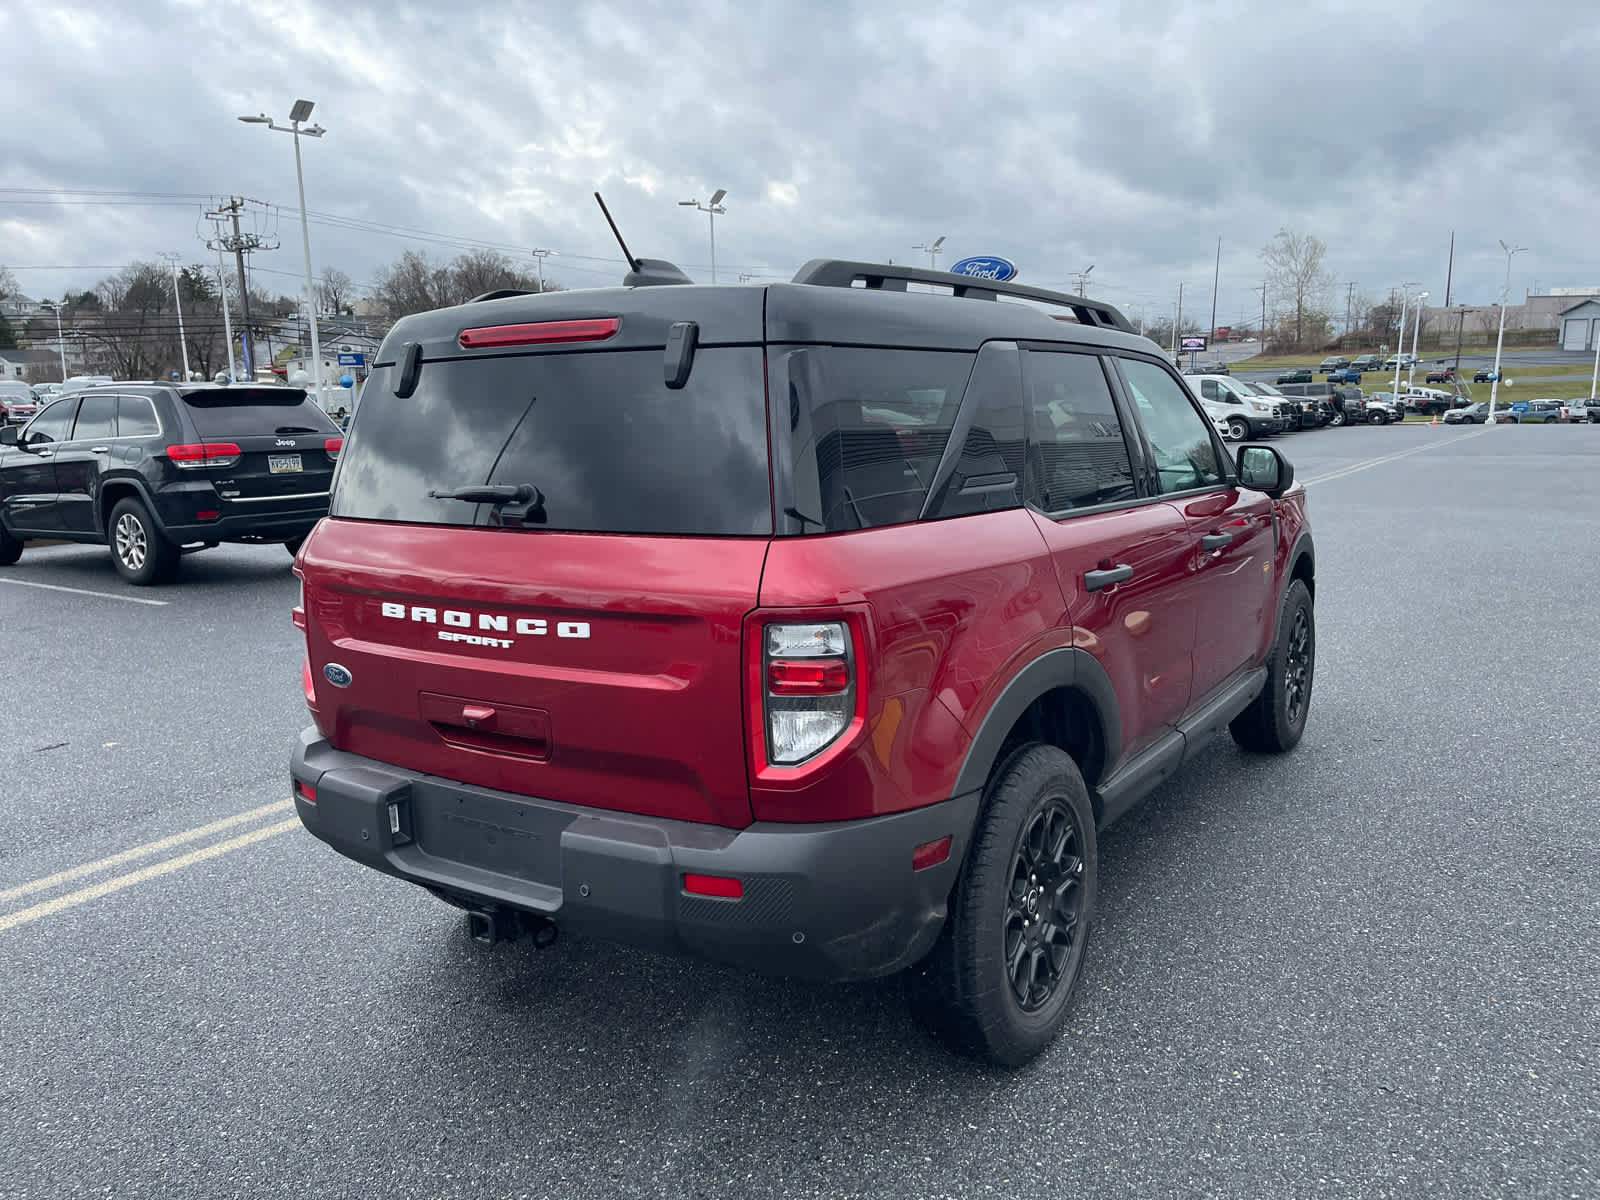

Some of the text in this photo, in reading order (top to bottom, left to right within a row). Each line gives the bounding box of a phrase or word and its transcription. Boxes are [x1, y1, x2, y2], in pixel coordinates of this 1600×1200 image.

[963, 261, 1001, 281] Ford
[275, 439, 296, 447] Jeep
[381, 602, 591, 638] BRONCO
[437, 630, 515, 649] SPORT
